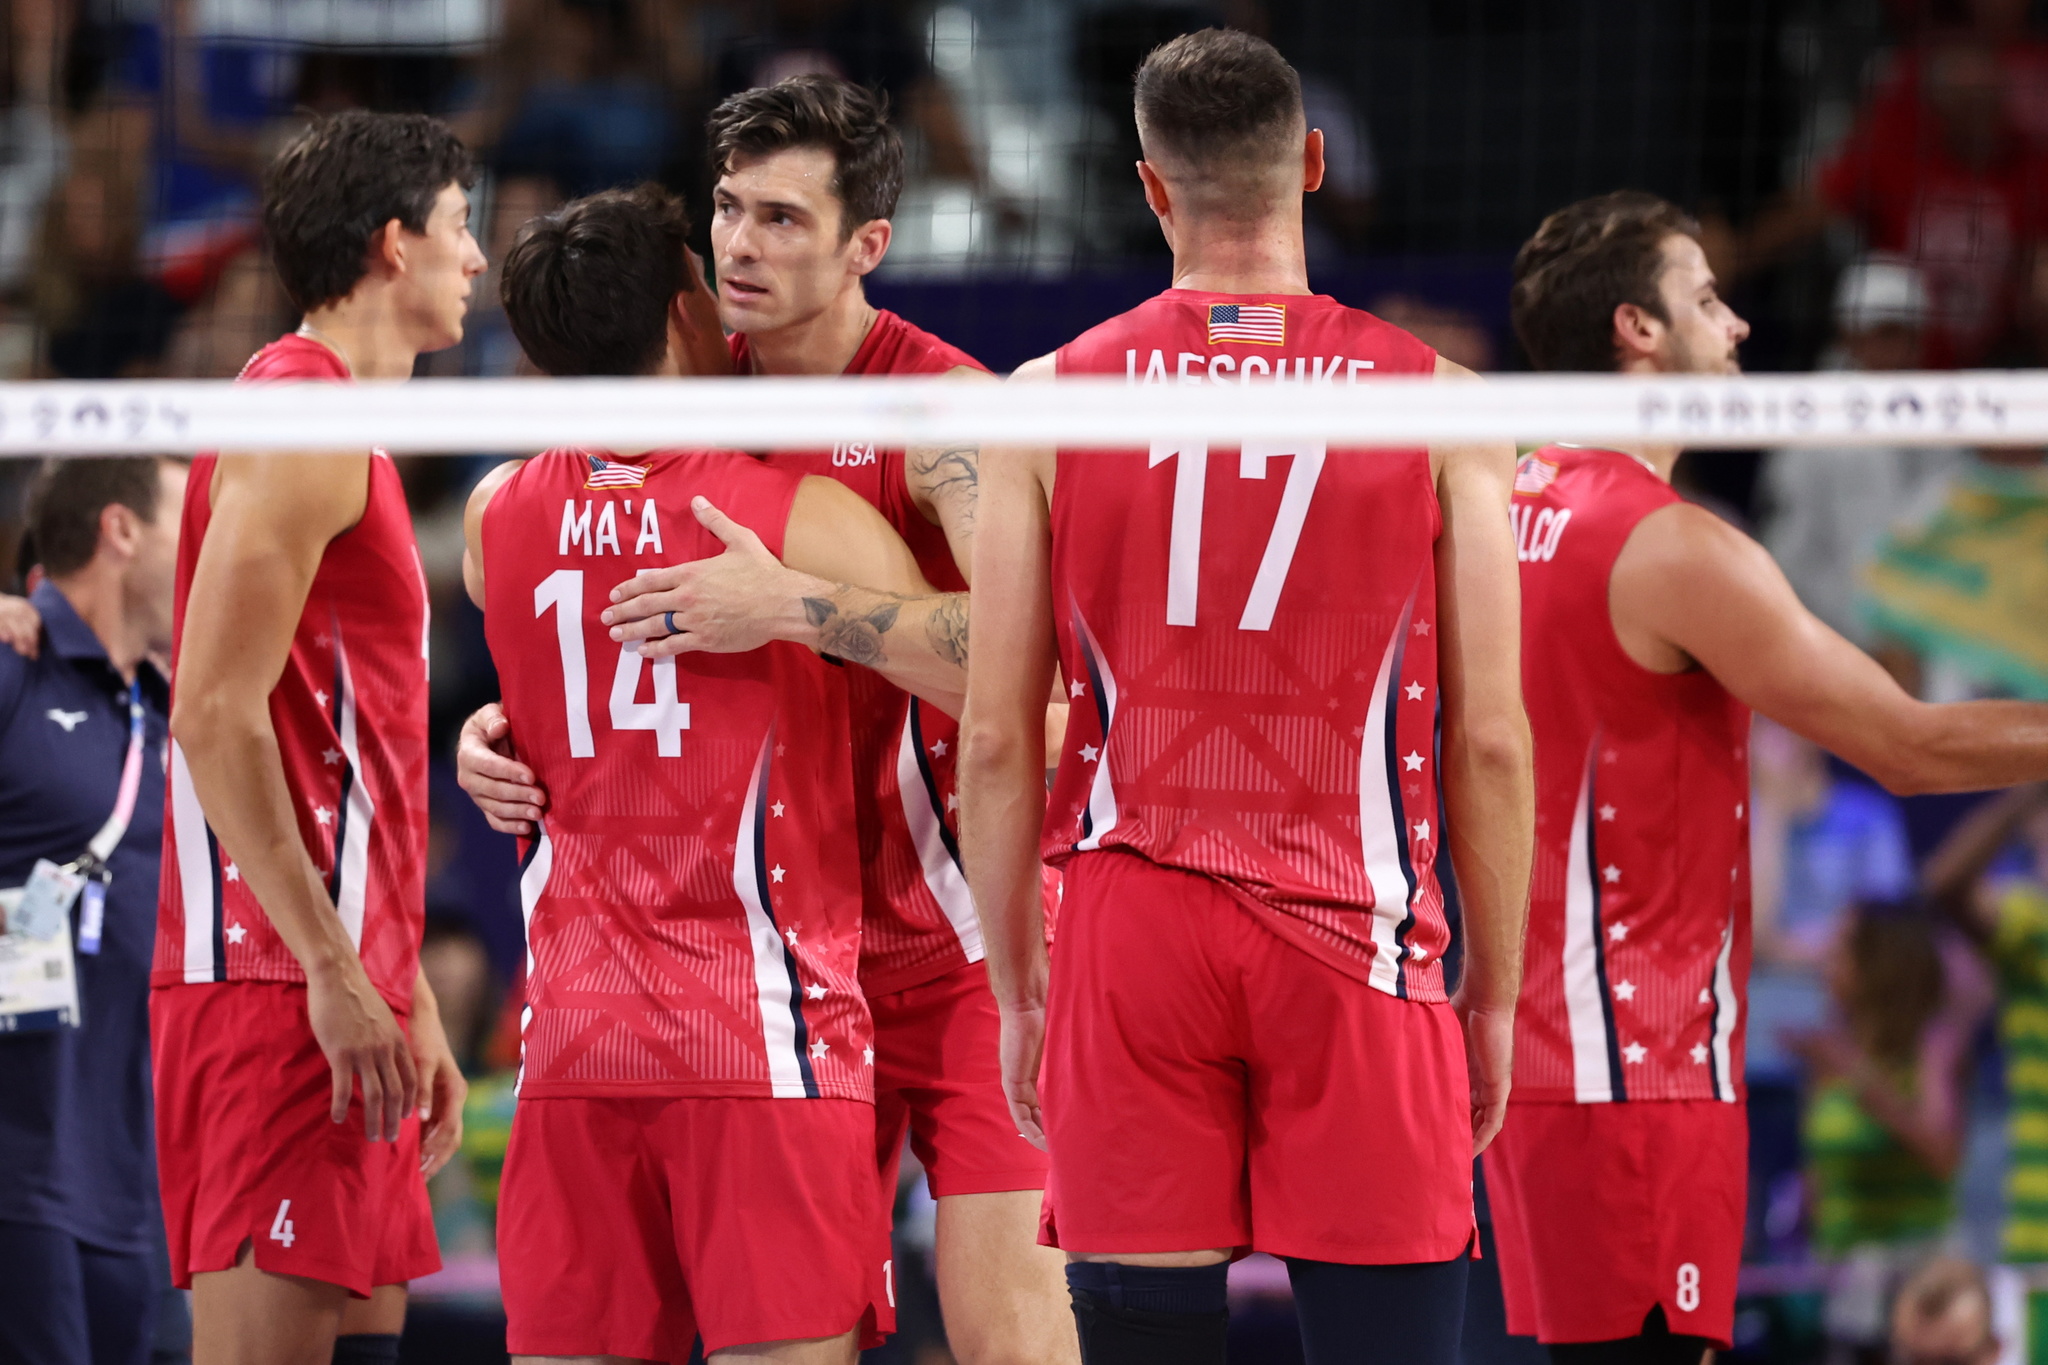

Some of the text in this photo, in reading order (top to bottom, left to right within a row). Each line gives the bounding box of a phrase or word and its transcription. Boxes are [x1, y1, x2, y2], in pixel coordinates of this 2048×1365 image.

[1638, 385, 1816, 433] PARIS
[831, 440, 876, 467] USA
[558, 498, 663, 556] MA'A
[1148, 437, 1327, 632] 17
[534, 568, 690, 758] 14
[269, 1198, 296, 1248] 4
[1676, 1262, 1700, 1312] 8
